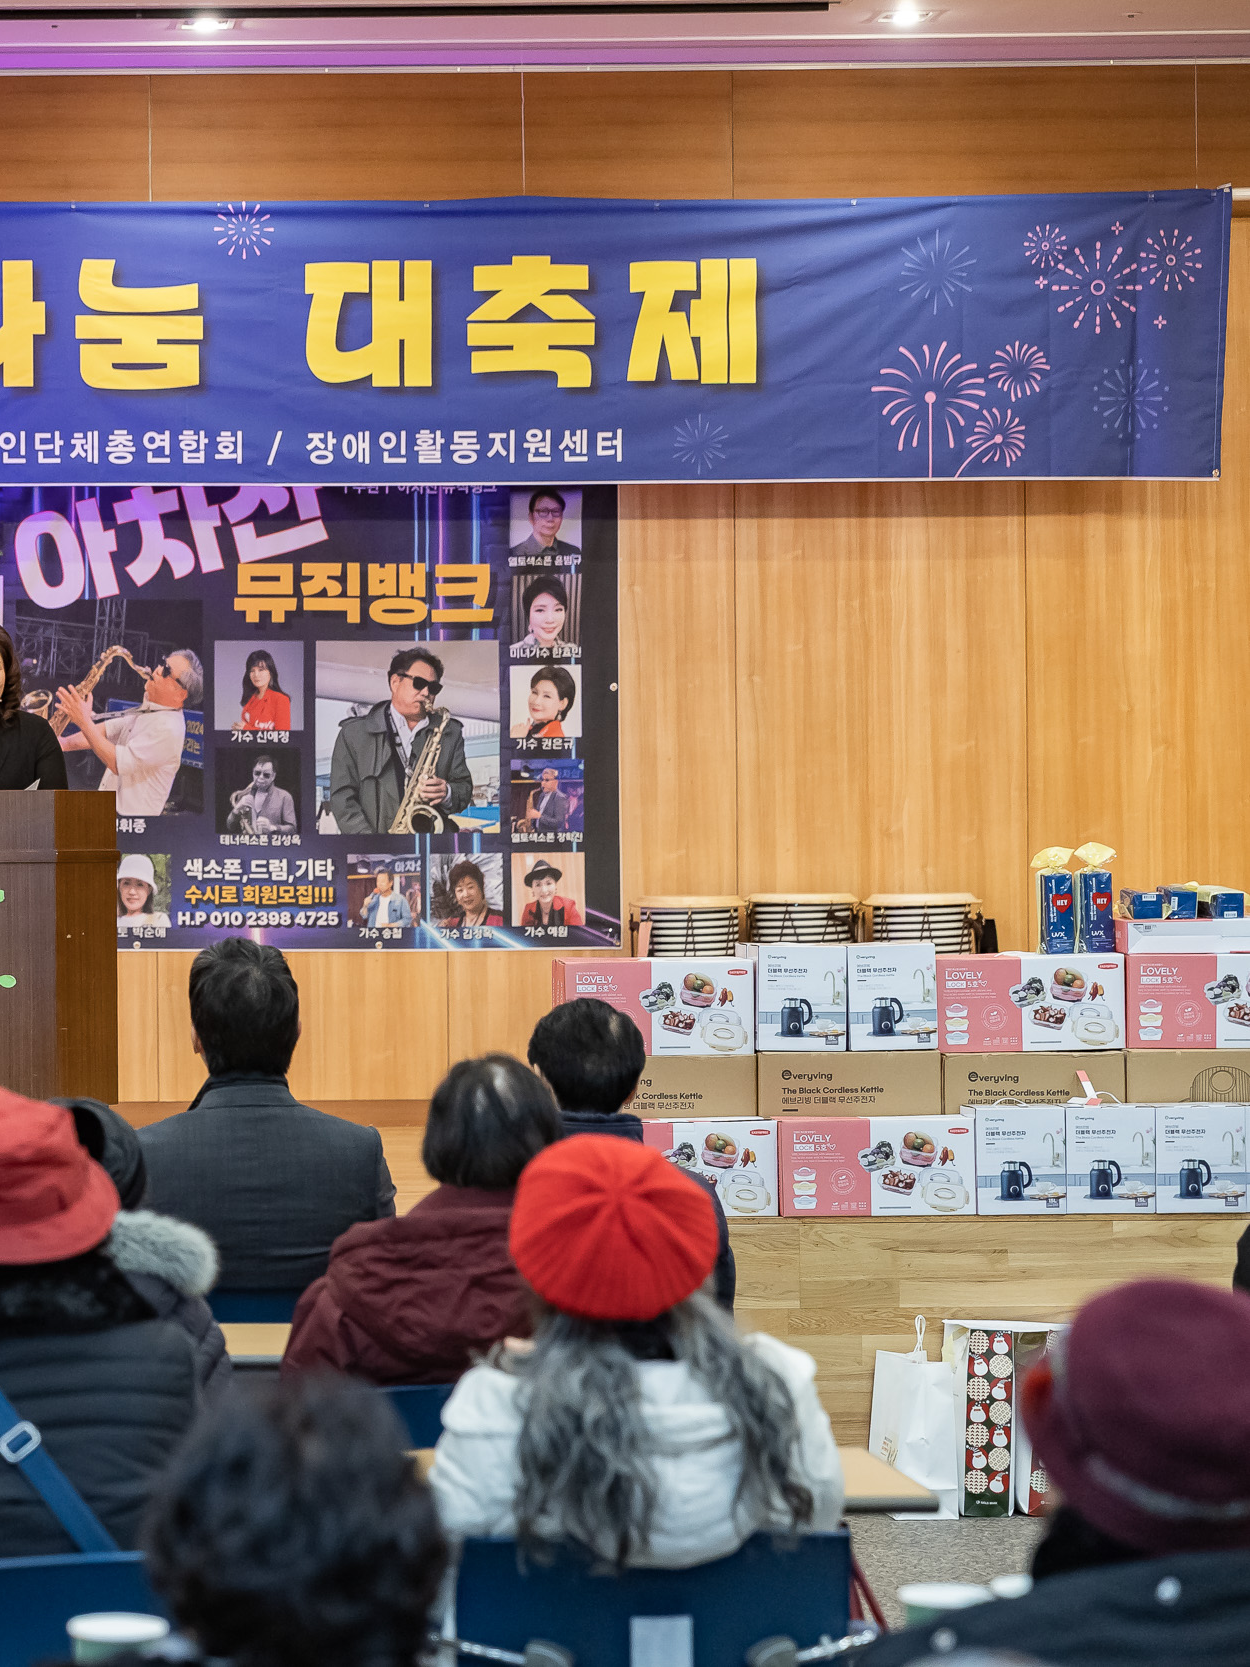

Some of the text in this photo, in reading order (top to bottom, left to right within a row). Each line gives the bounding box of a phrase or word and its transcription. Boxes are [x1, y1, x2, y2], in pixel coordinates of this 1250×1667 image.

[304, 255, 757, 389] 대축제
[304, 427, 625, 464] 장애인활동지원센터
[233, 562, 495, 626] 뮤직뱅크
[230, 730, 254, 743] 가수
[515, 738, 538, 751] 가수
[116, 818, 147, 834] 휘종
[219, 834, 268, 846] 테너색소폰
[183, 858, 335, 884] 색소폰,드럼,기타
[184, 884, 334, 905] 수시로 회원모집!!!
[177, 911, 339, 926] H.P 010 2398 4725
[359, 927, 380, 939] 가수
[440, 928, 460, 940] 가수
[524, 926, 545, 938] 가수
[945, 970, 983, 980] LOVELY
[1140, 966, 1178, 975] LOVELY
[576, 974, 614, 984] LOVELY
[781, 1069, 833, 1081] everyving
[968, 1071, 1020, 1083] everyving
[822, 1086, 859, 1094] Cordless
[781, 1096, 811, 1104] 에브리빙
[813, 1096, 836, 1104] 더블랙
[793, 1133, 832, 1143] LOVELY
